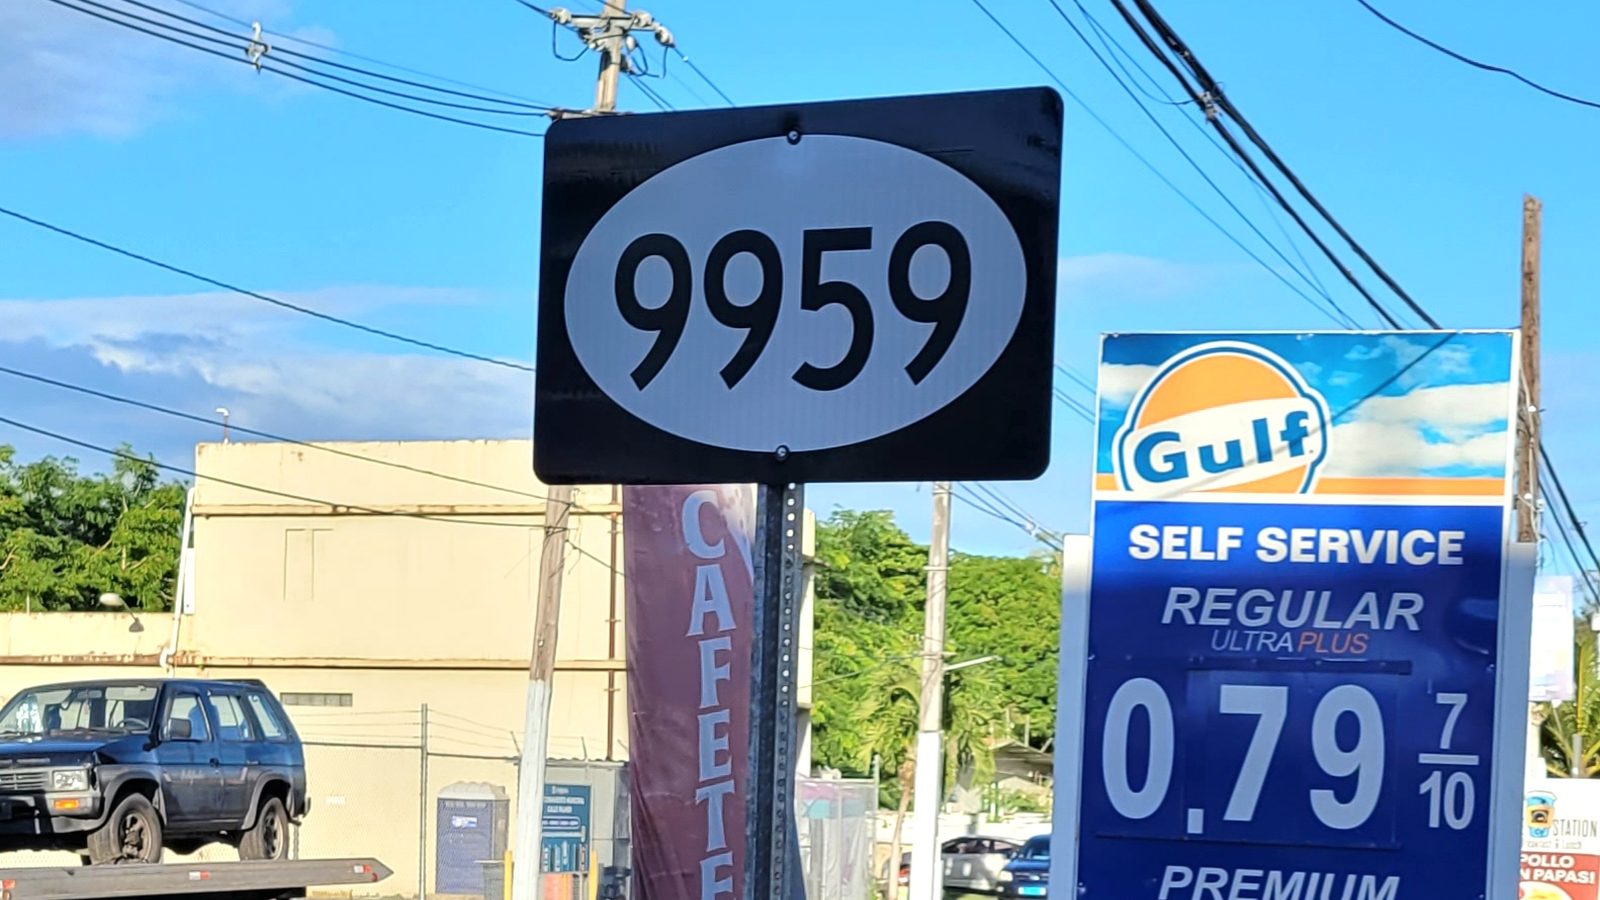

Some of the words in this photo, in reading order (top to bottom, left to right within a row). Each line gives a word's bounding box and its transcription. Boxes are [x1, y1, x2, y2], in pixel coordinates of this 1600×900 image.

[615, 221, 972, 392] 9959
[1133, 410, 1309, 483] Gulf
[1128, 524, 1244, 561] SELF
[1256, 527, 1466, 566] SERVICE
[1161, 586, 1424, 631] REGULAR
[1211, 629, 1294, 653] ULTRA
[1297, 632, 1370, 654] PLUS
[1436, 692, 1468, 750] 7
[1102, 677, 1386, 835] 0.79
[1418, 770, 1476, 830] 10
[1553, 819, 1598, 838] STATION
[1157, 865, 1400, 900] PREMIUM
